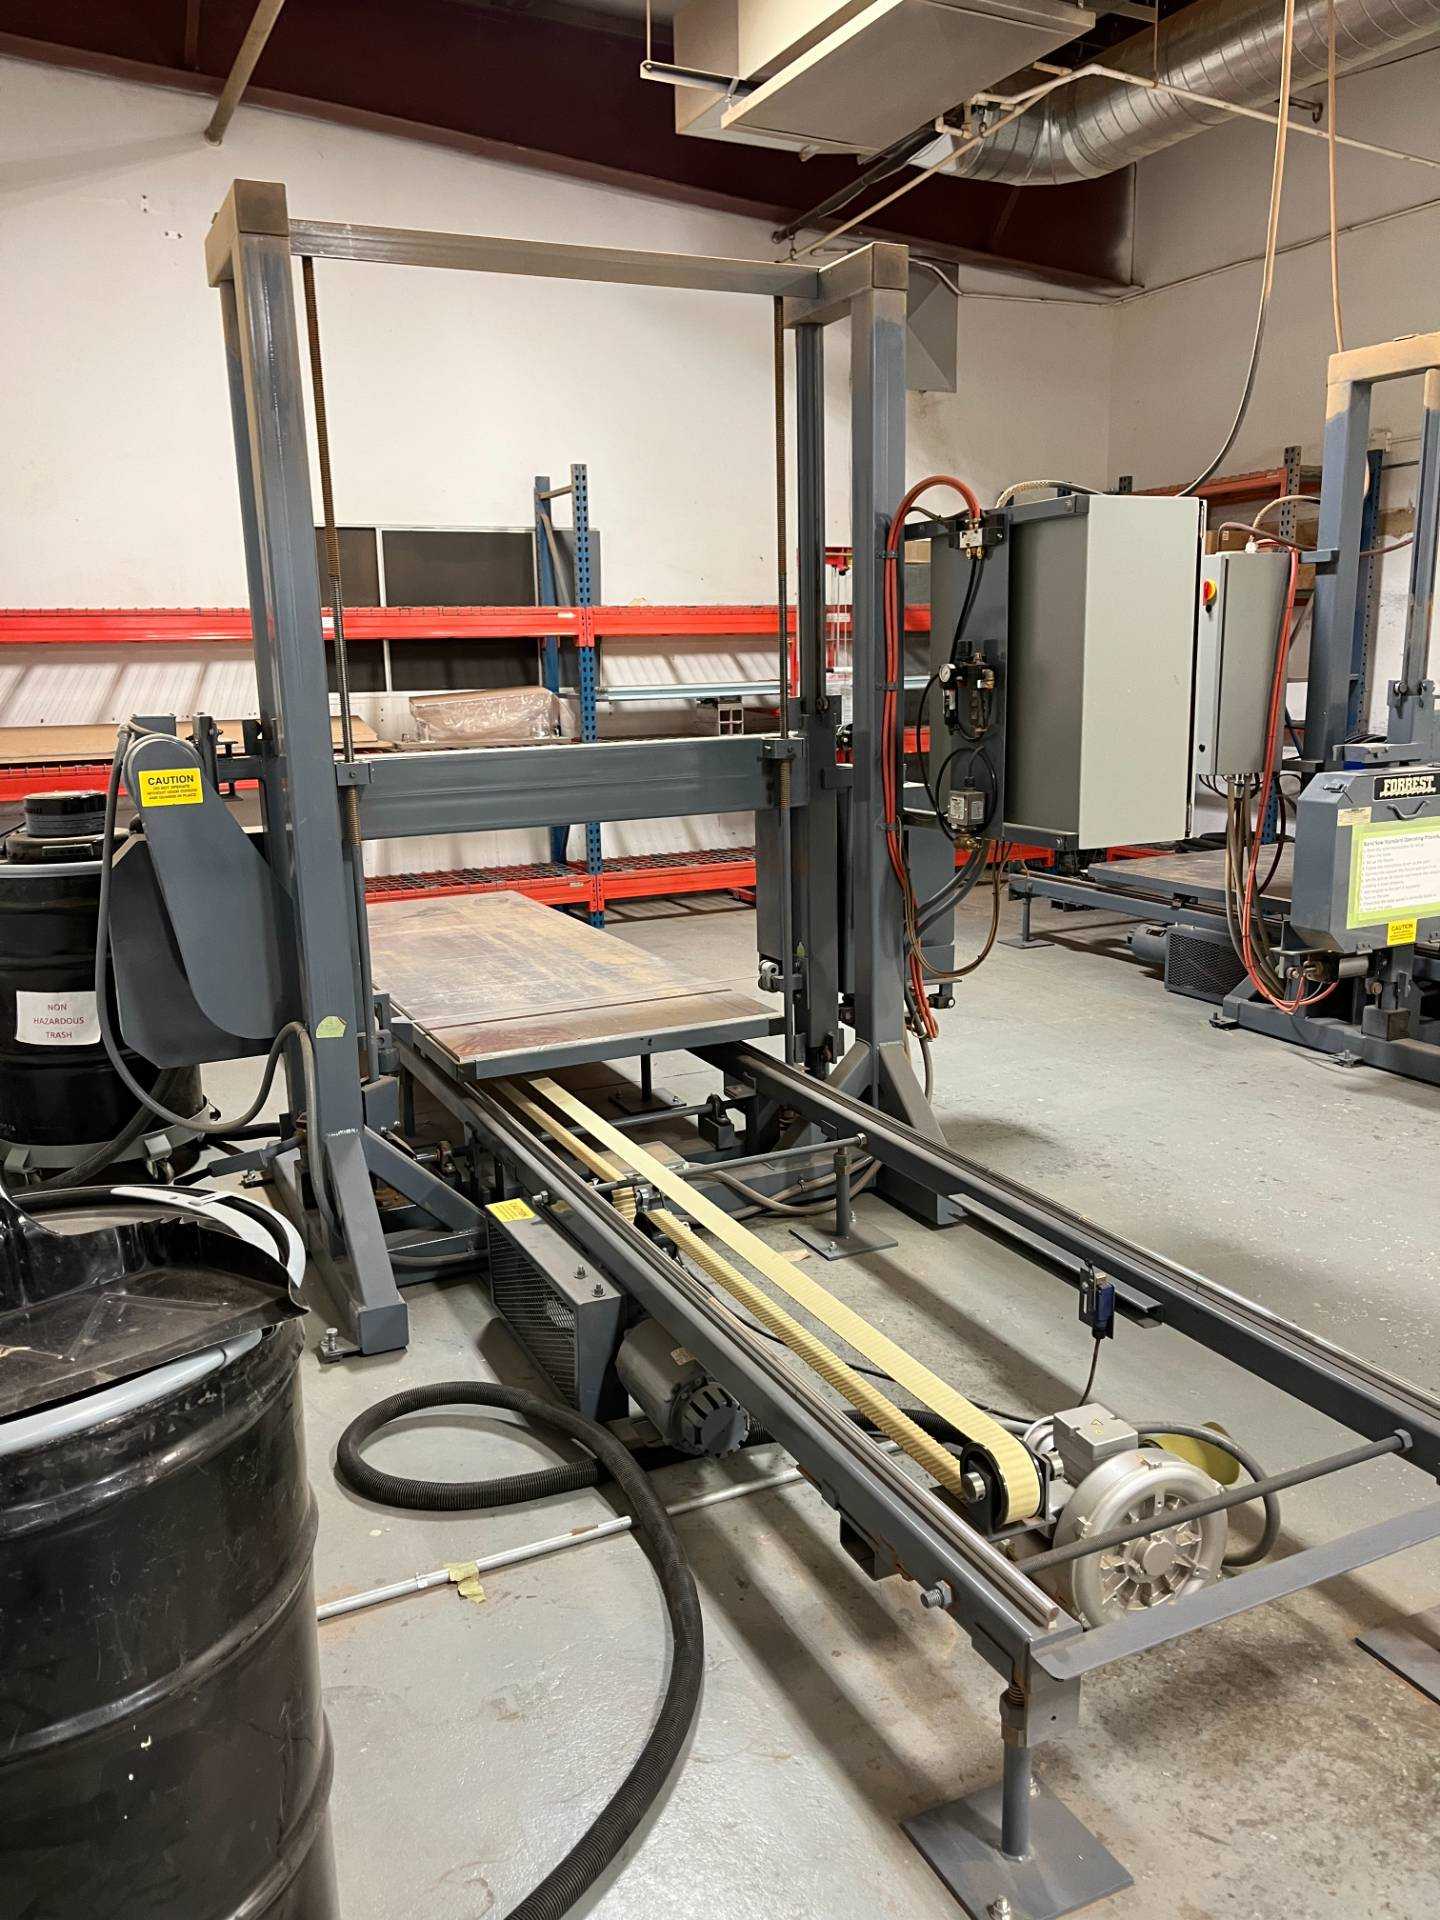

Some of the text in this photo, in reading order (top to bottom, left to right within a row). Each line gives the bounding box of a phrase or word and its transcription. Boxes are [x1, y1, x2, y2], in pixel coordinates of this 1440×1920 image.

[148, 775, 194, 785] CAUTION
[1382, 775, 1435, 794] FORREST
[1391, 923, 1413, 931] CAUTION
[48, 1003, 67, 1011] NON
[33, 1017, 84, 1025] HAZARDOUS
